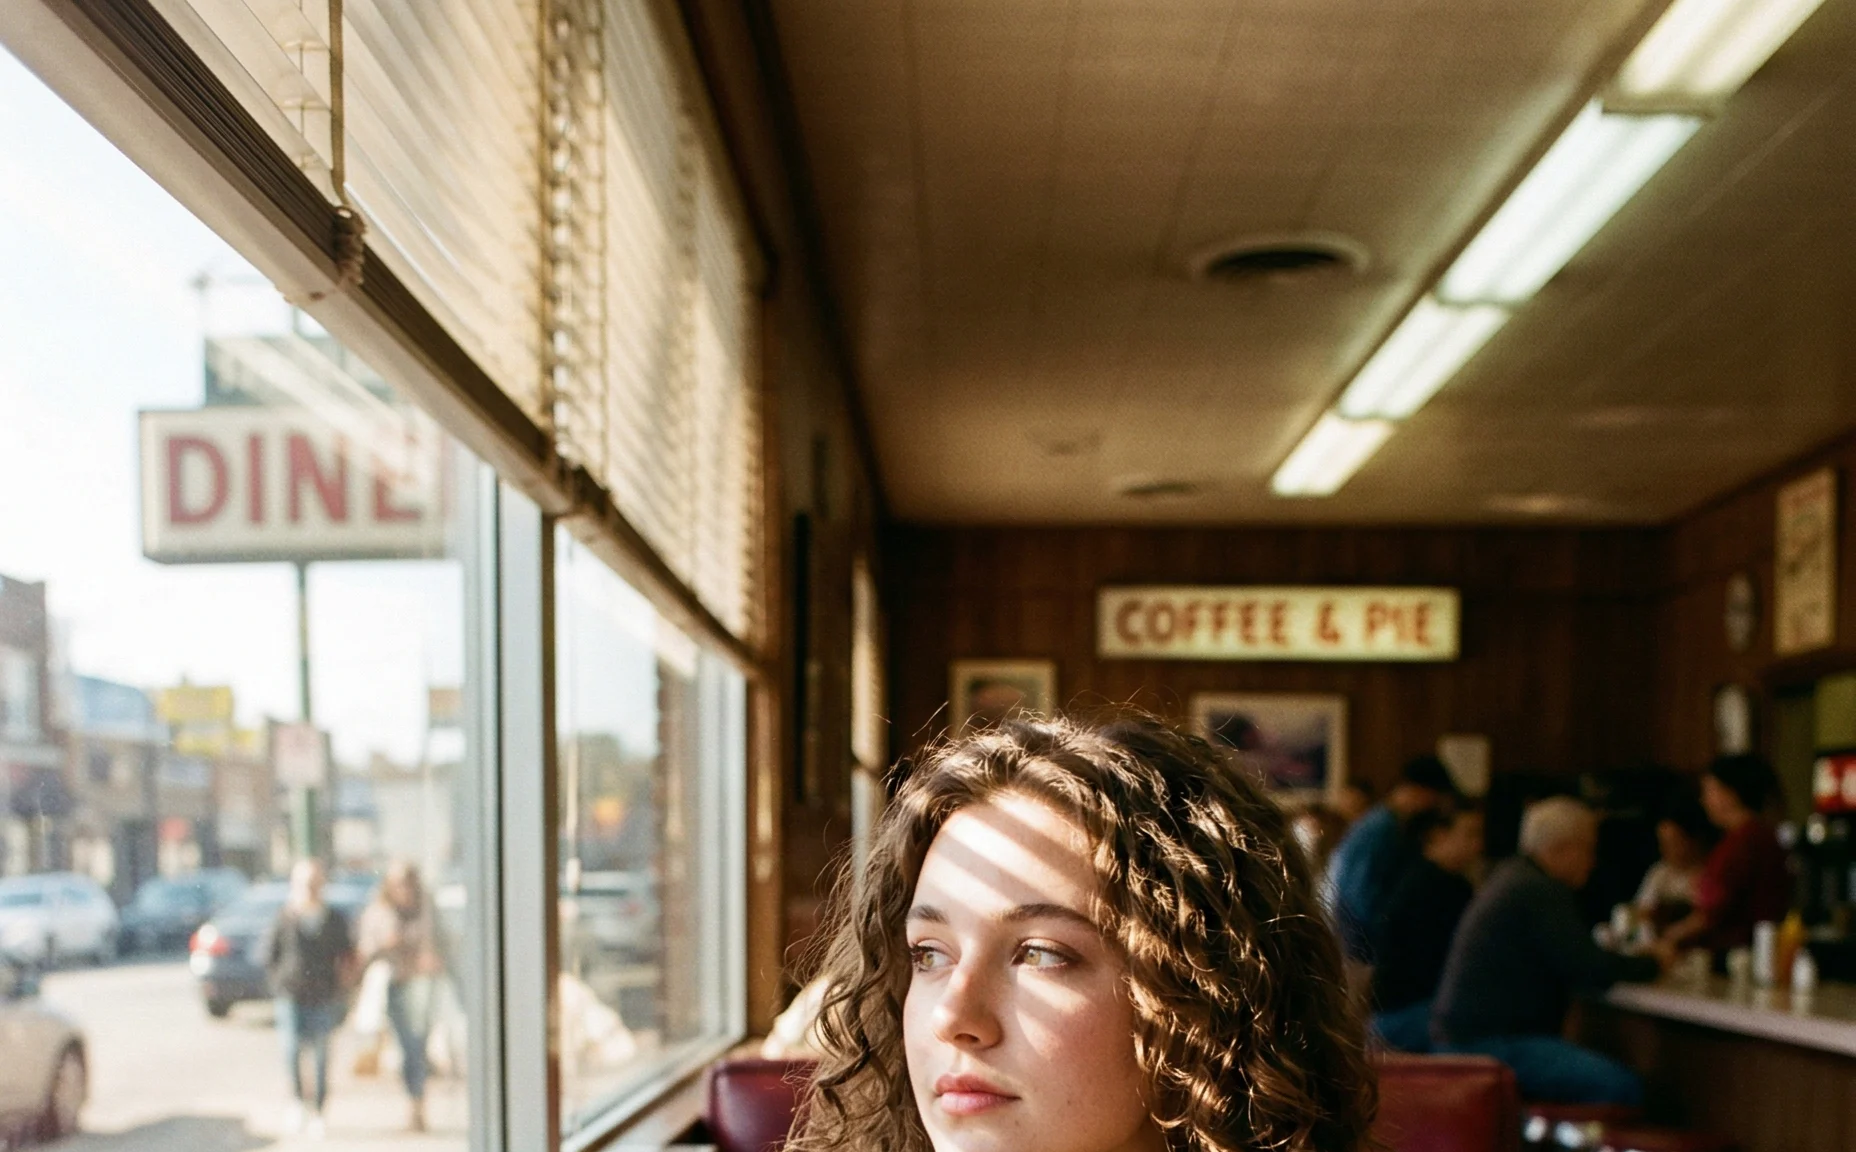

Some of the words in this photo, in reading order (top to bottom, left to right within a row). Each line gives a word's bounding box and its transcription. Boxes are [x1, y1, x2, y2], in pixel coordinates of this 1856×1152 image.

[165, 433, 444, 525] DINE
[1115, 600, 1291, 645] COFFEE
[1316, 602, 1343, 645] &
[1365, 601, 1434, 646] PIE
